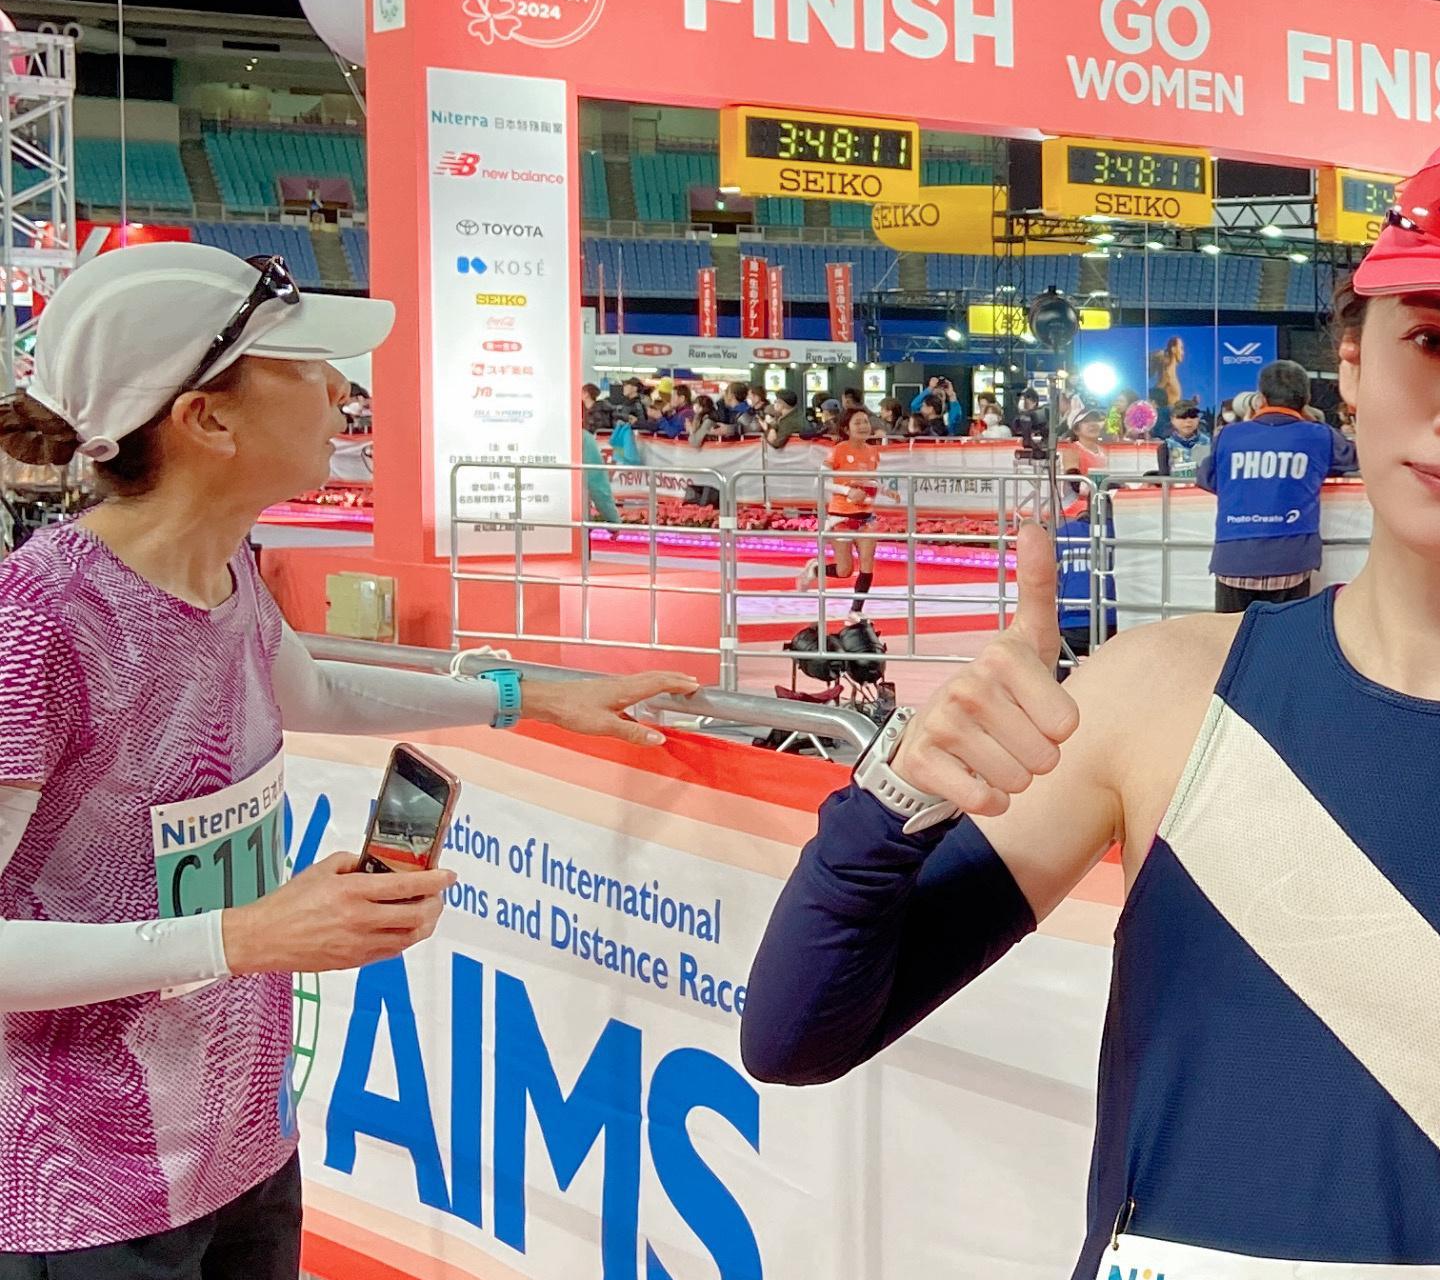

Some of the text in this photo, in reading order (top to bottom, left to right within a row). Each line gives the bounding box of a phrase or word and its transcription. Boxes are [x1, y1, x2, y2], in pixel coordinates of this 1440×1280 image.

[517, 1, 562, 20] 2024
[1065, 55, 1245, 117] WOMEN
[431, 110, 489, 128] Niterra
[778, 122, 907, 165] 3:48:11
[481, 168, 508, 180] new
[511, 169, 565, 185] balance
[779, 168, 882, 198] SEIKO
[1093, 151, 1201, 189] 3:48:11
[873, 202, 940, 231] SEIKO
[1095, 192, 1181, 219] SEIKO
[481, 222, 544, 238] TOYOTA
[493, 258, 546, 277] KOSÉ
[475, 293, 527, 307] SEIKO
[688, 348, 706, 359] Run
[722, 348, 738, 360] You
[805, 352, 823, 362] Run
[836, 352, 853, 363] You
[1230, 450, 1309, 481] PHOTO
[646, 472, 695, 491] alance
[161, 797, 260, 849] Niterra
[508, 837, 537, 878] of
[541, 841, 721, 944] International
[496, 896, 541, 941] and
[550, 904, 669, 990] Distance
